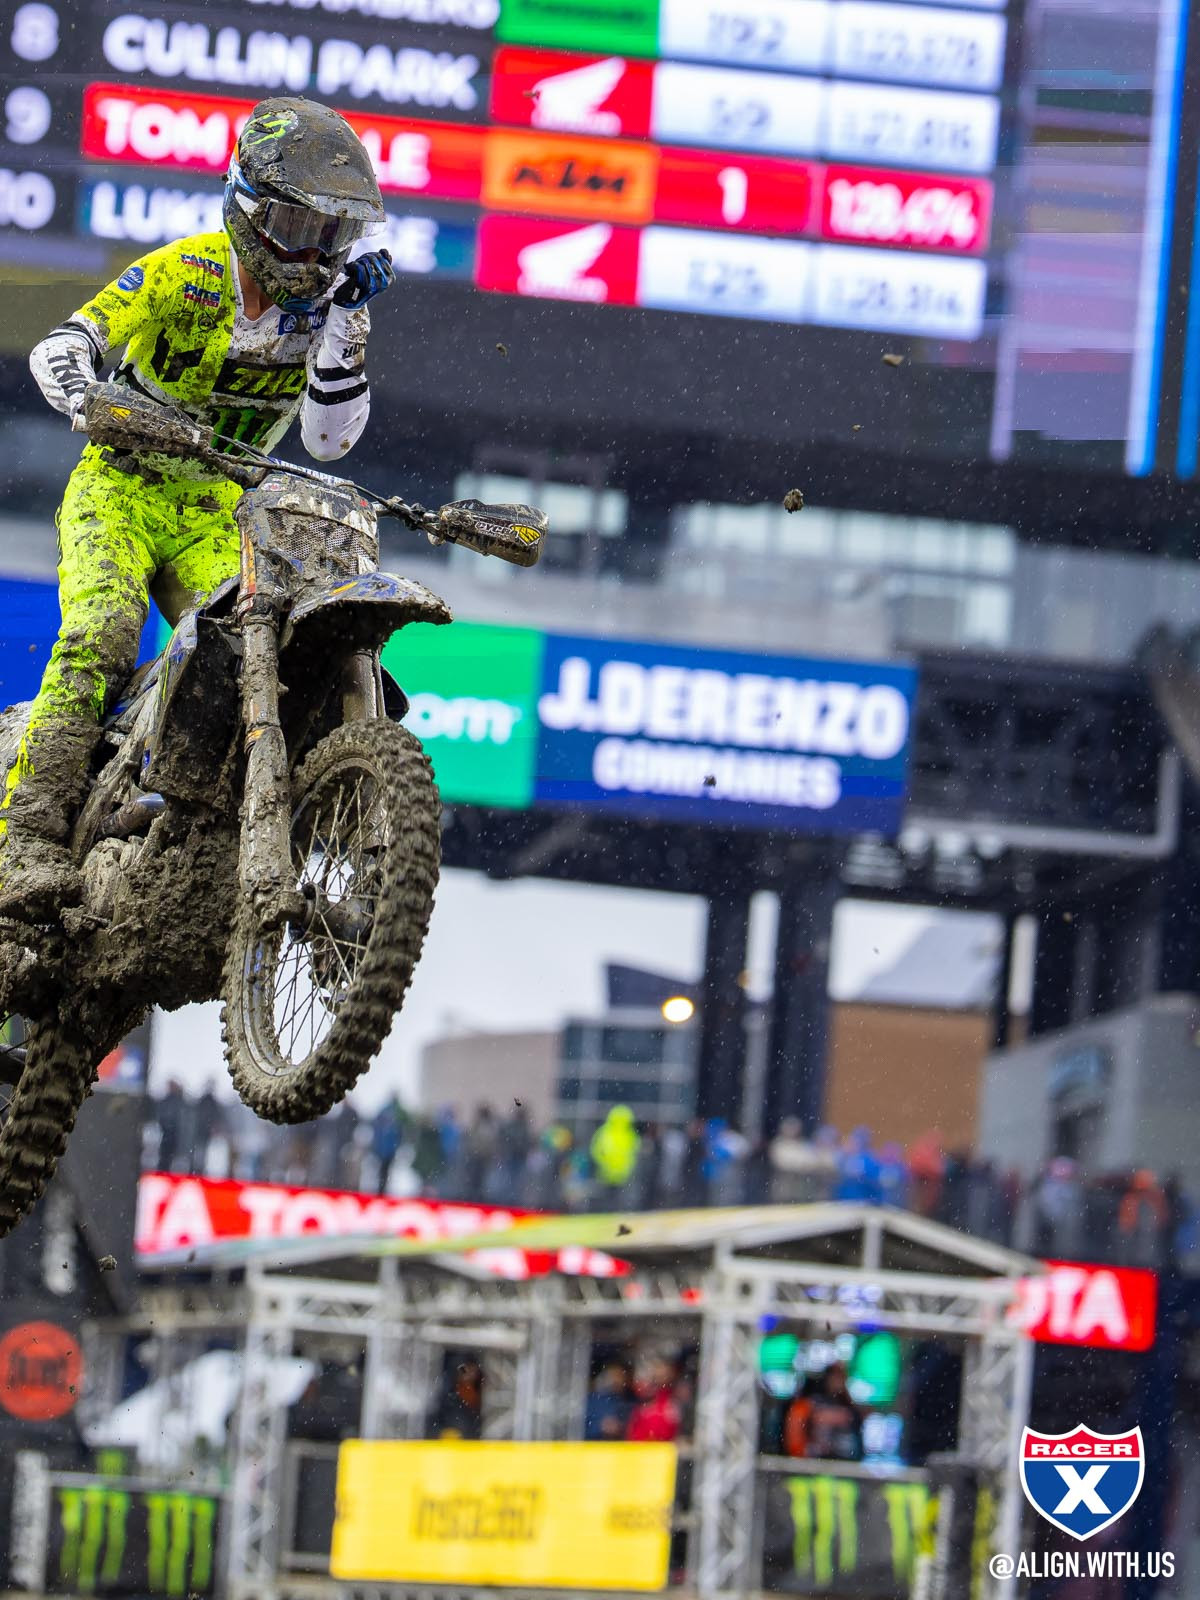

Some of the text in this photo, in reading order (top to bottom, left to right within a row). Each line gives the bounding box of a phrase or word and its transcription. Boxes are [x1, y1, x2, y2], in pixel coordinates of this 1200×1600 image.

[11, 2, 59, 61] 8
[103, 14, 313, 89] CULLIN
[316, 39, 480, 111] PARK
[4, 86, 51, 144] 9
[96, 97, 230, 166] TOM
[717, 167, 749, 224] 1
[538, 656, 909, 760] J.DERENZO
[592, 737, 842, 810] COMPANIES
